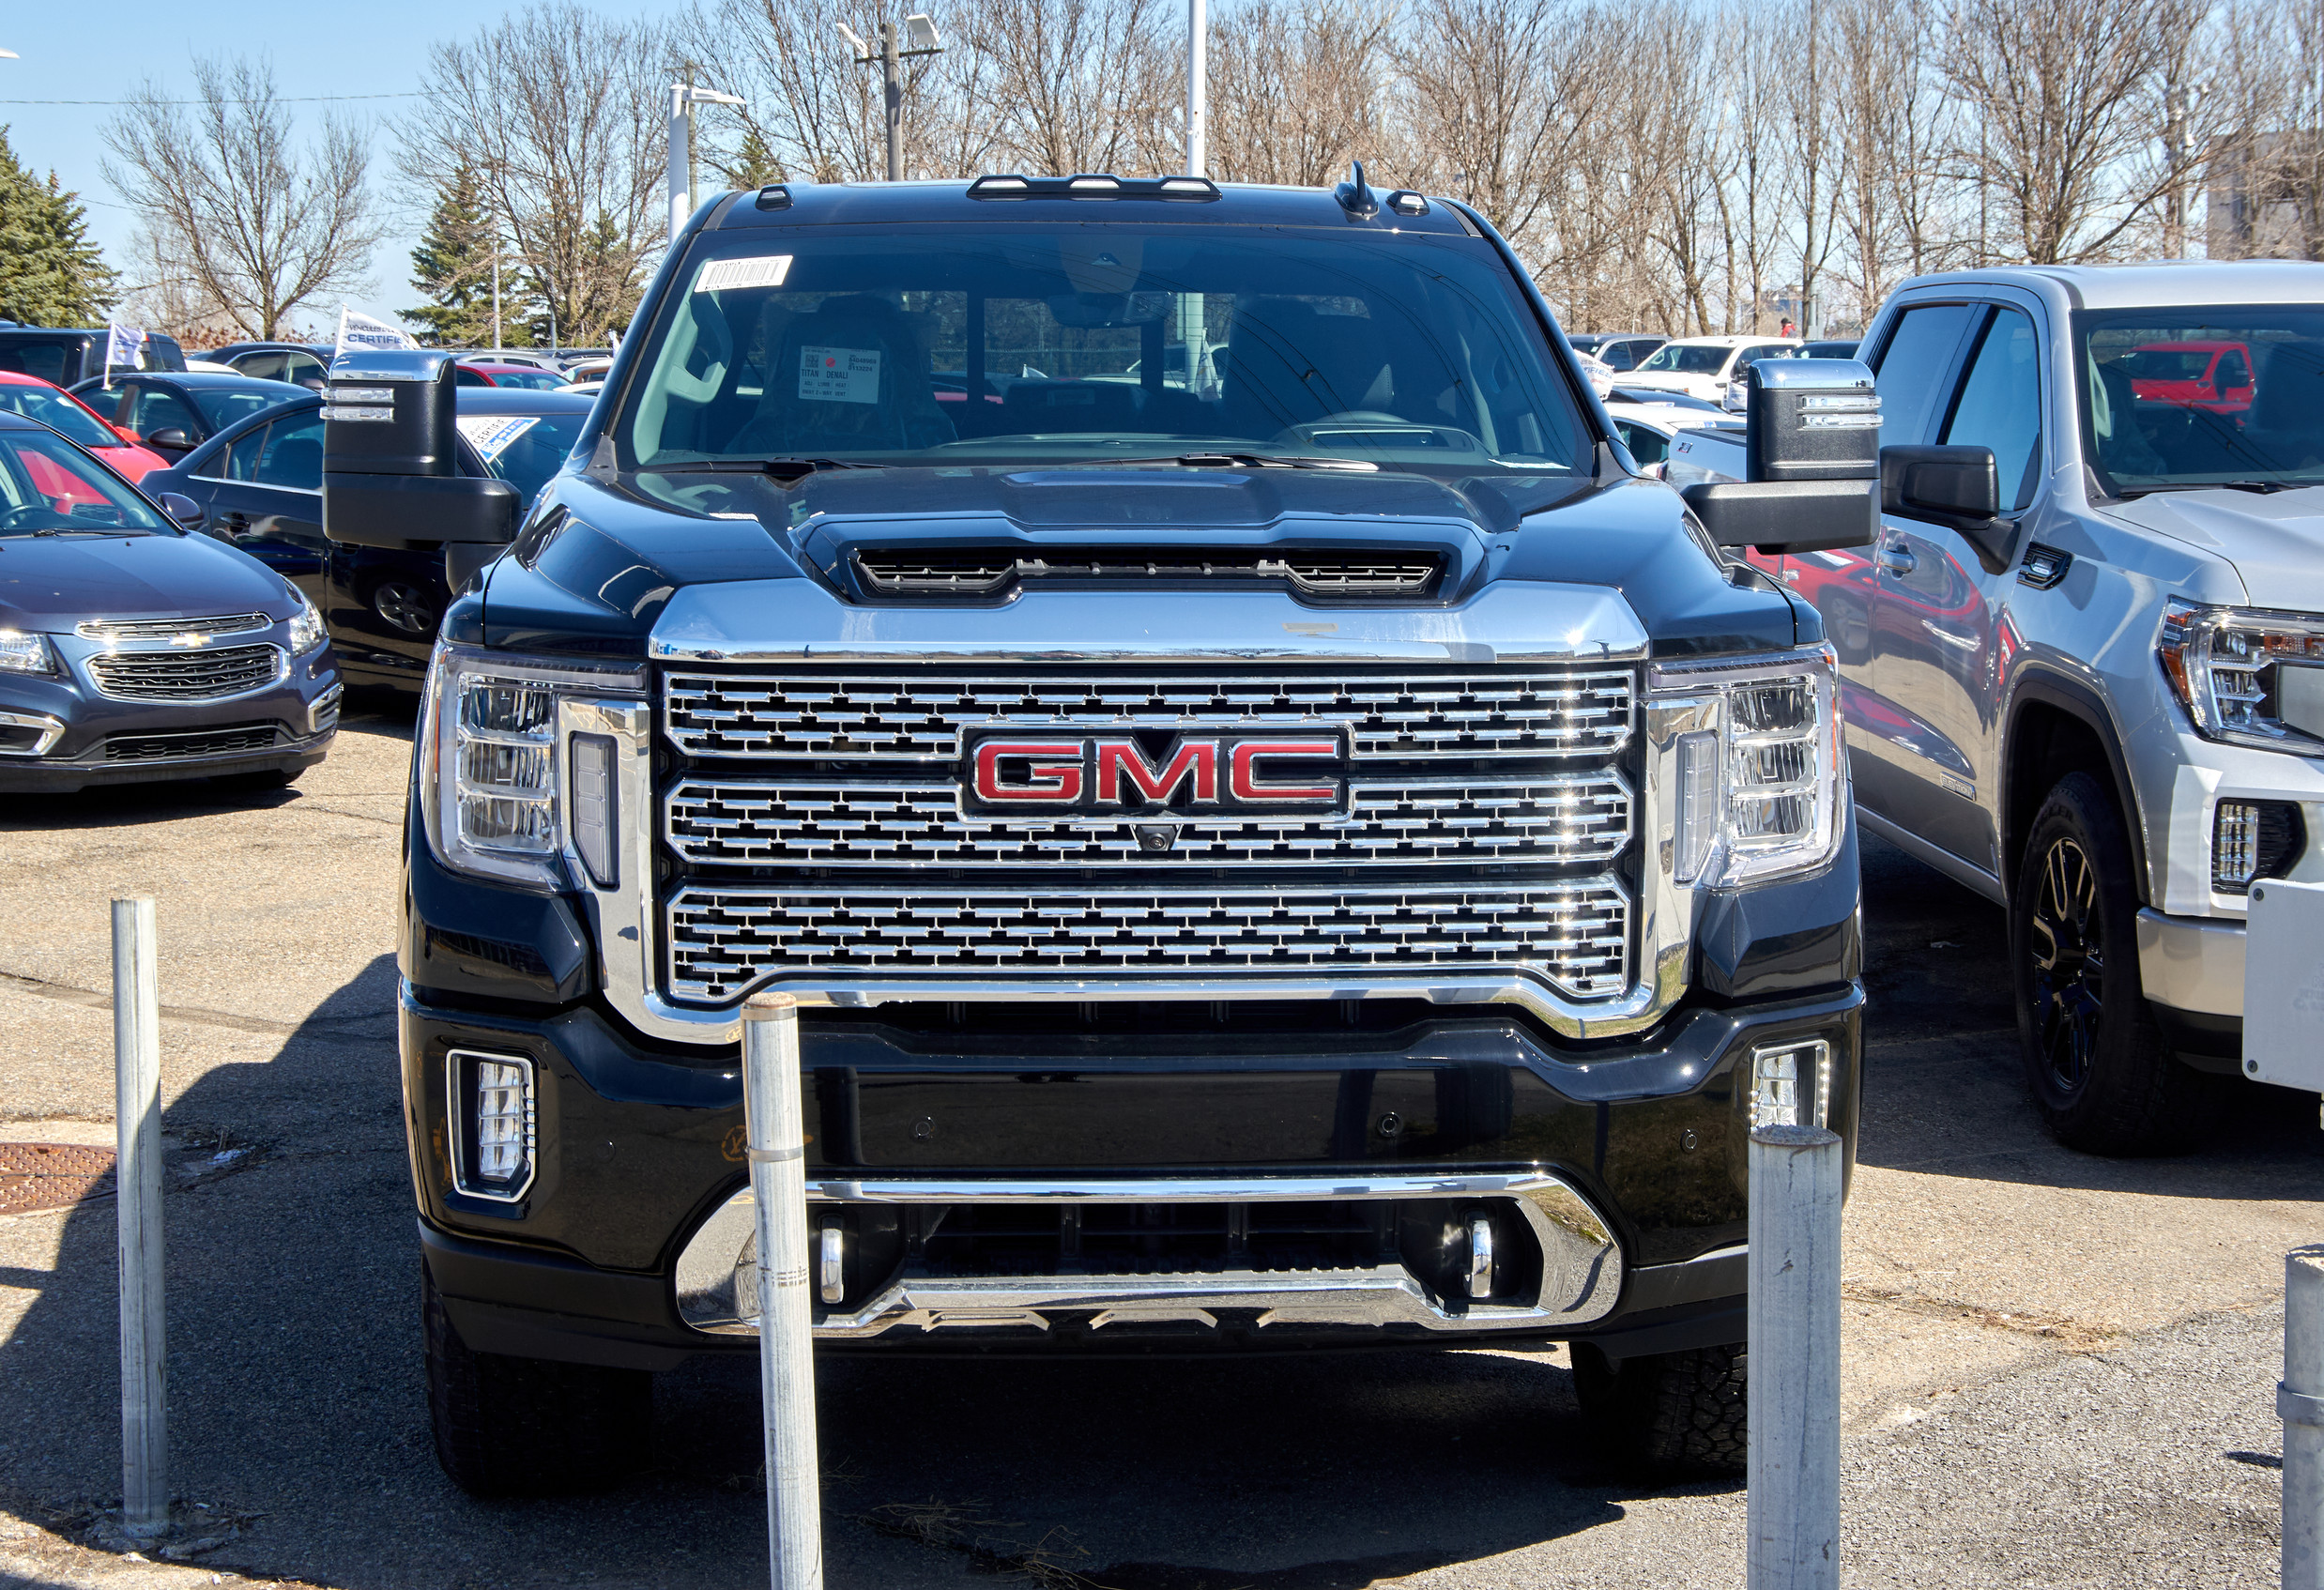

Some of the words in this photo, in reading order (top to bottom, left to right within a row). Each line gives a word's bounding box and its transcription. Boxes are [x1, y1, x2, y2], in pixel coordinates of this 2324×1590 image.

[802, 369, 819, 378] TITAN
[826, 371, 849, 379] DENALI
[972, 736, 1340, 806] GMC
